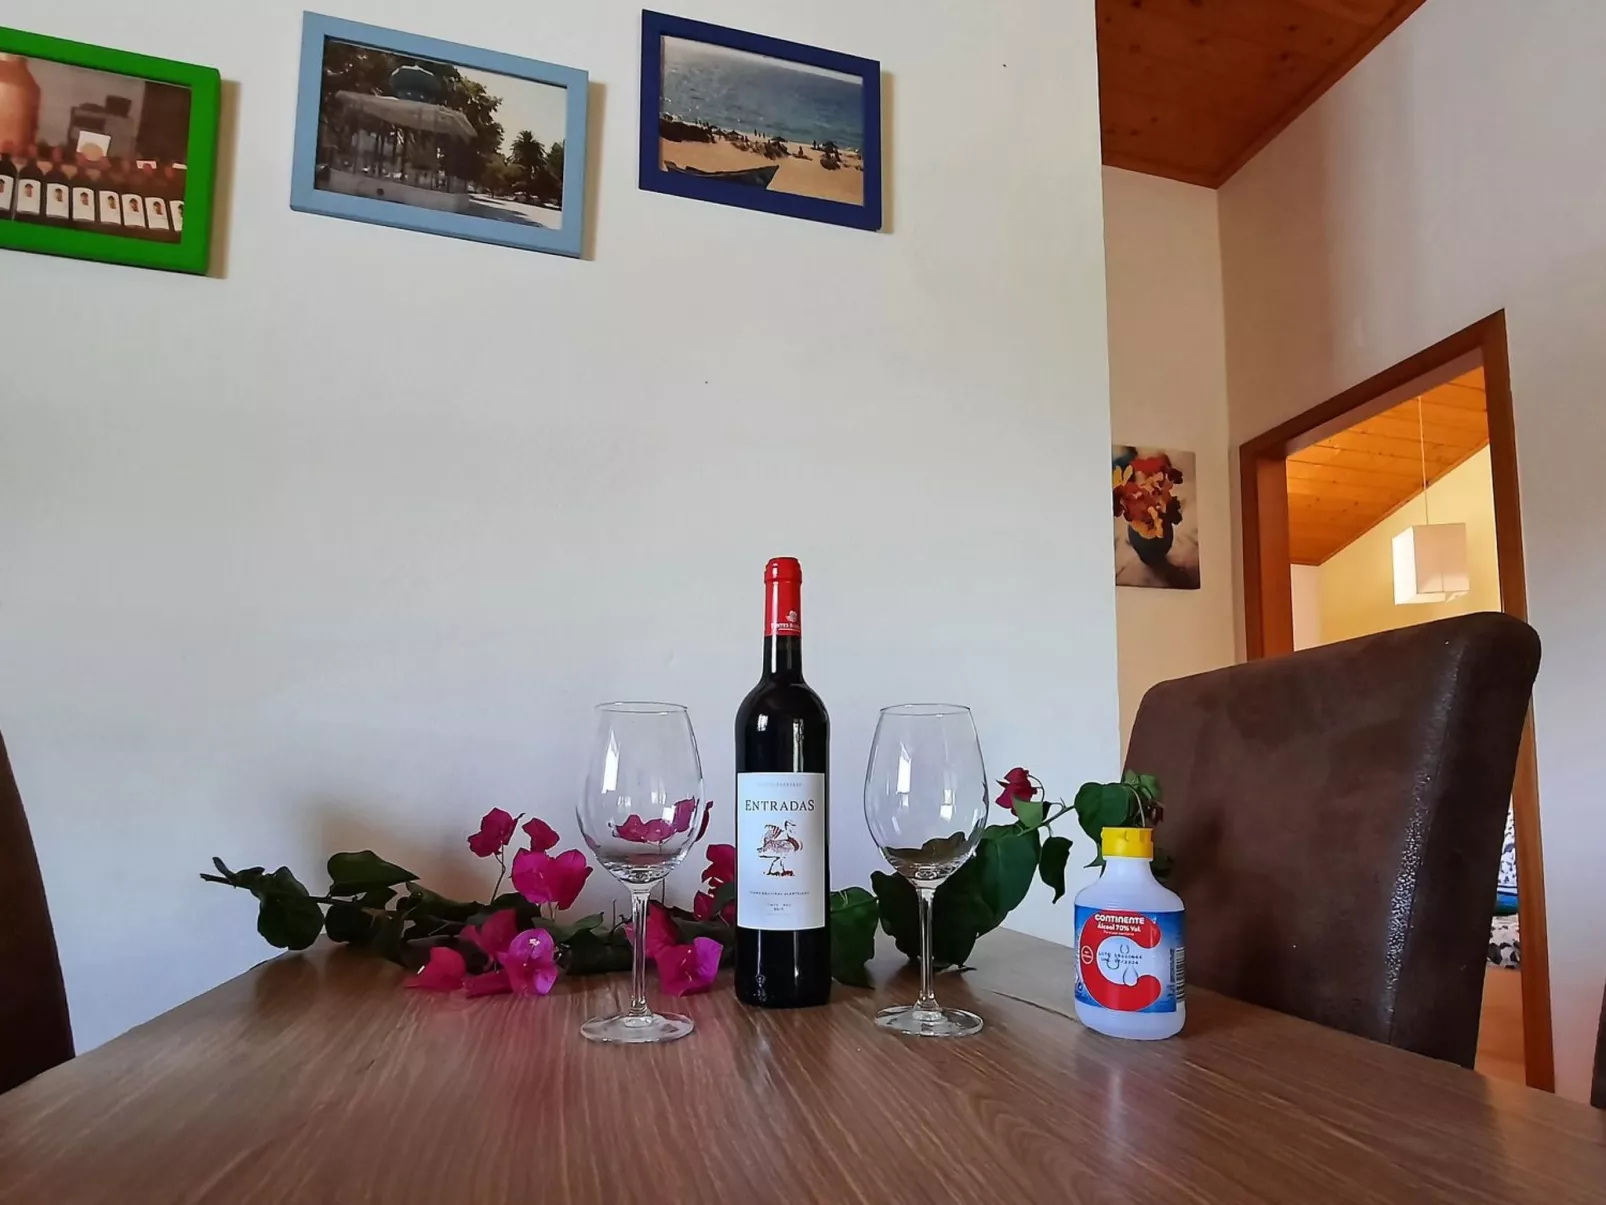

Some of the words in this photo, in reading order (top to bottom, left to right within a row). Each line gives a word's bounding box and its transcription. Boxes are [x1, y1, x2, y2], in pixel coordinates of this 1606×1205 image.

[745, 799, 815, 812] ENTRADAS
[1094, 913, 1145, 925] CONTINENTE
[1115, 924, 1129, 932] 70%
